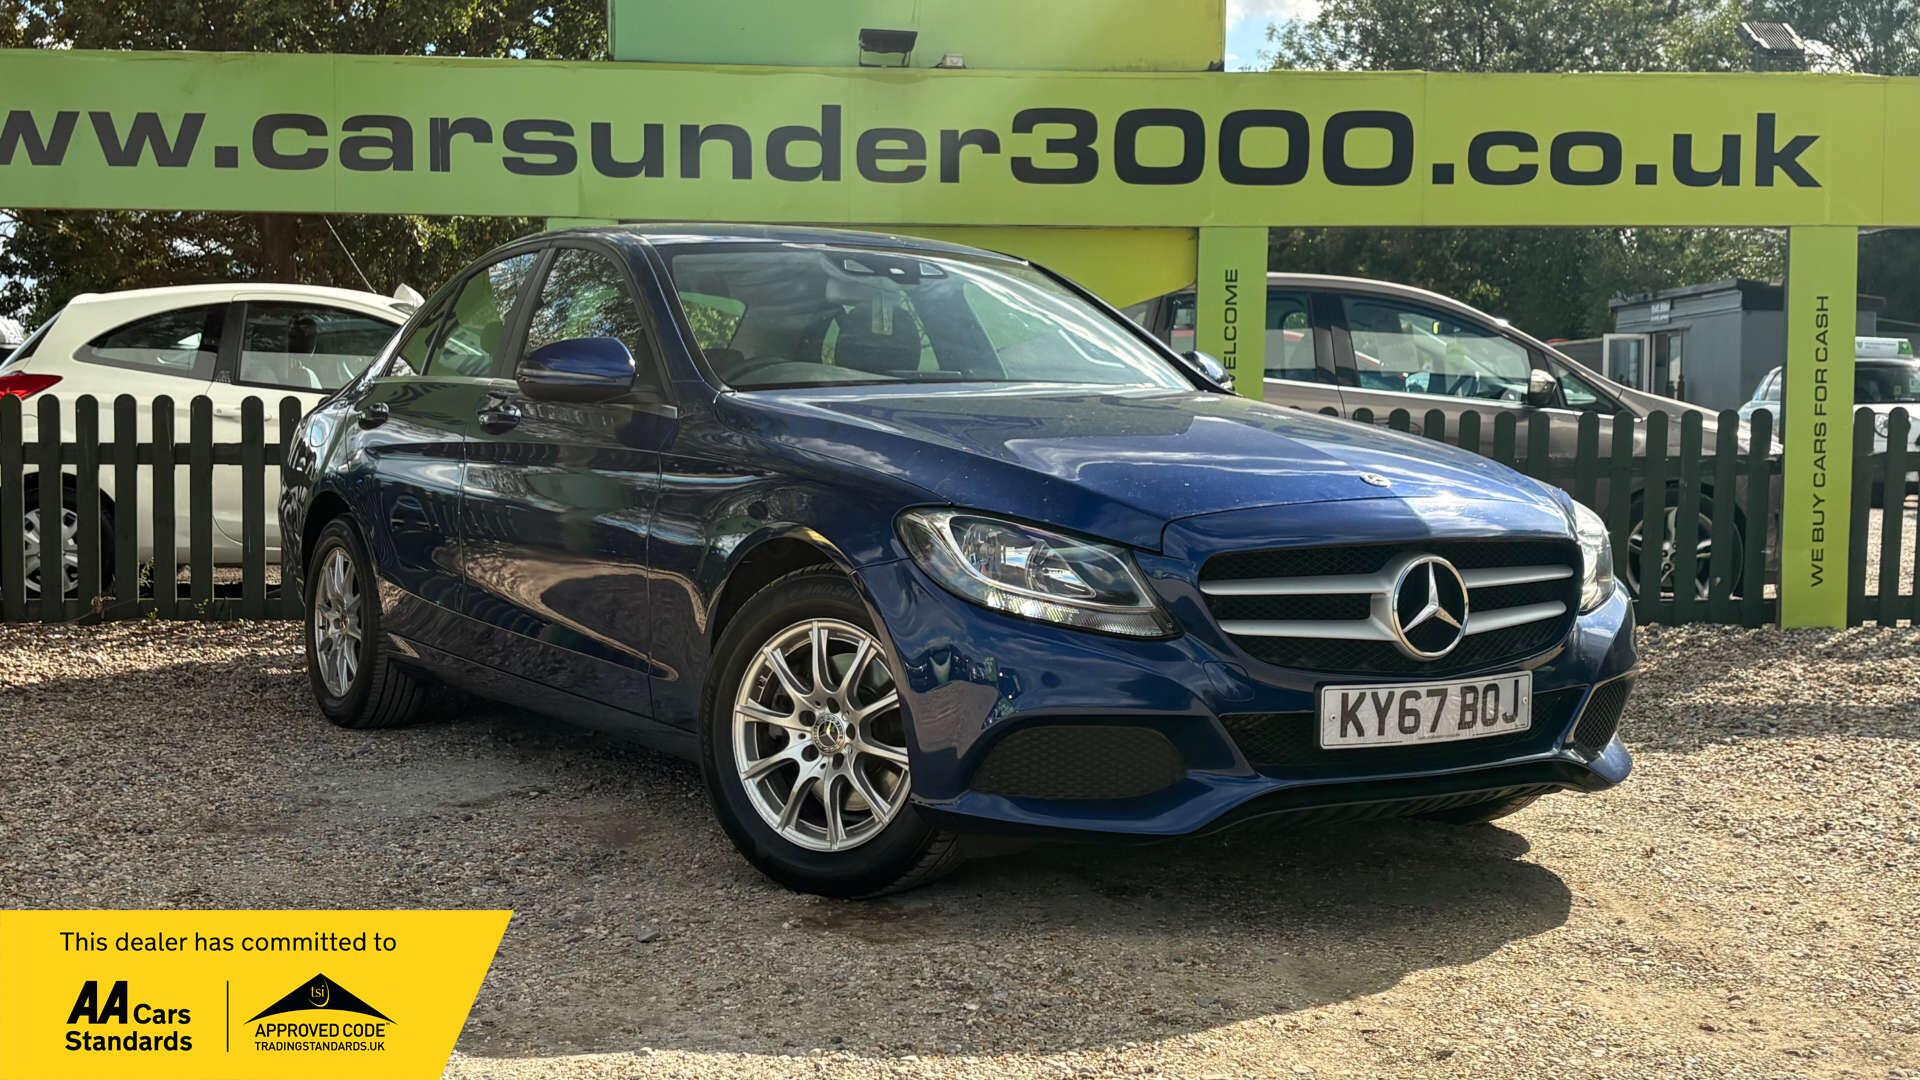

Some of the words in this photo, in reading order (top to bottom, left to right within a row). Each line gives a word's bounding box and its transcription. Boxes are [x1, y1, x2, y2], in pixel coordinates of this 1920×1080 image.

[1815, 295, 1829, 363] CASH
[1814, 368, 1828, 417] FOR
[1812, 421, 1828, 488] CARS
[1811, 492, 1826, 543] BUY
[1810, 547, 1825, 588] WE
[1339, 687, 1448, 738] KY67
